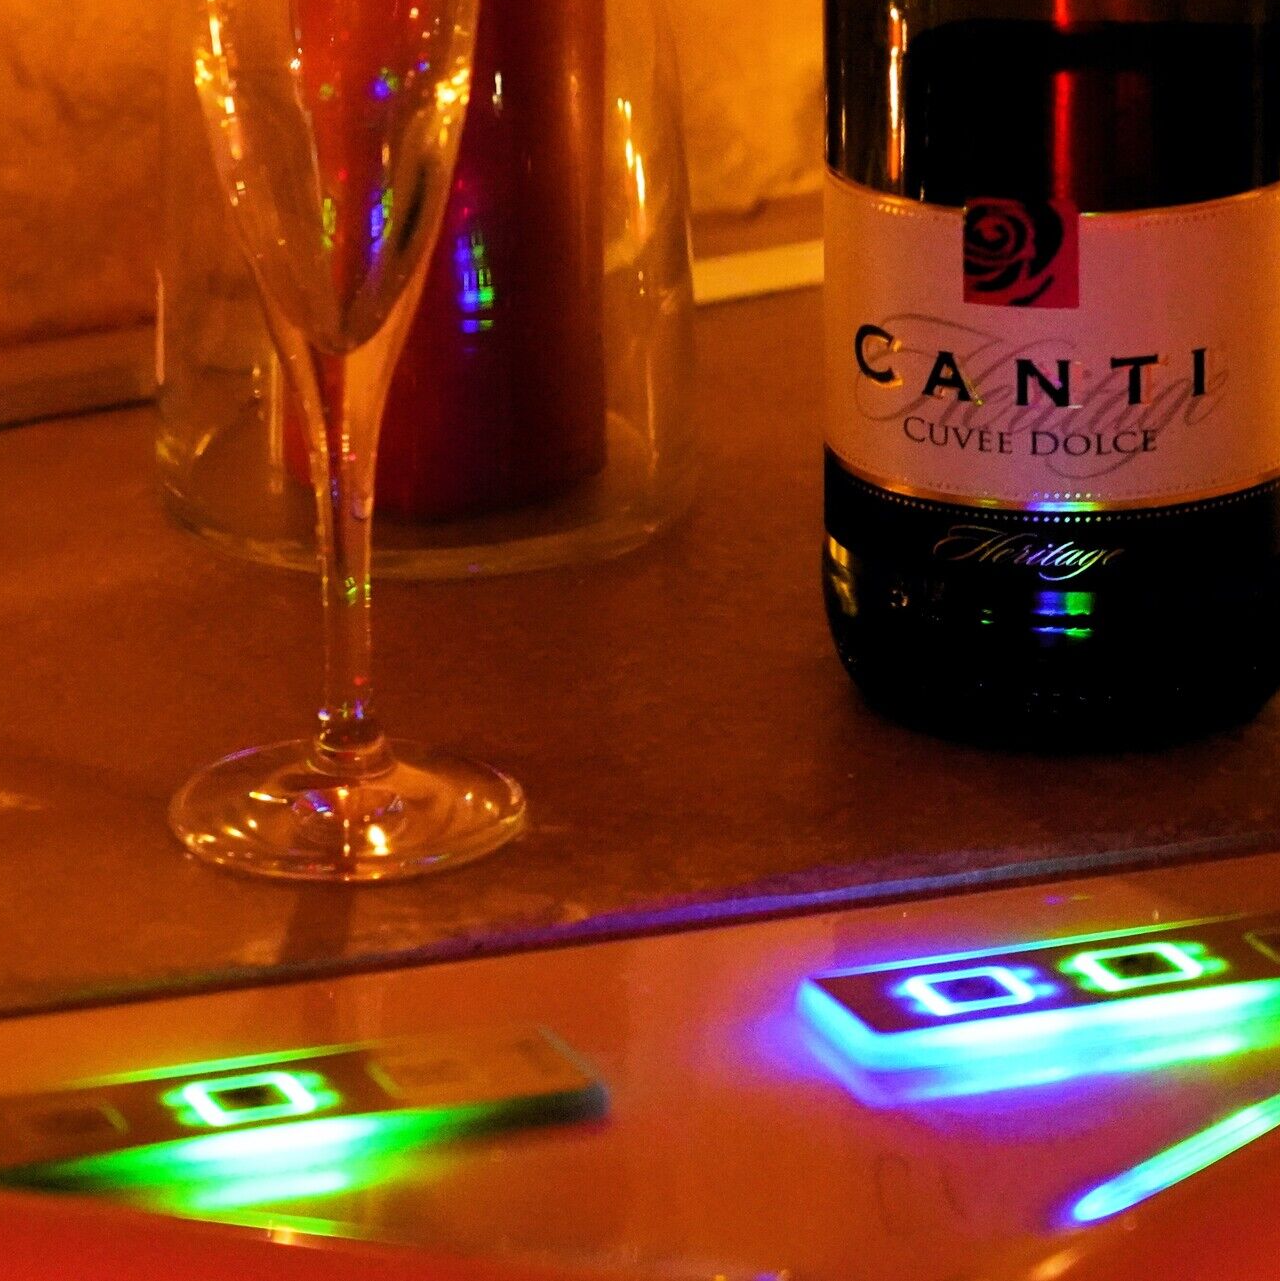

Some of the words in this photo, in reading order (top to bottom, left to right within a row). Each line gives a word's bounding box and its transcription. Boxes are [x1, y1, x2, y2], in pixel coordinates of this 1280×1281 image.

[854, 324, 1208, 408] CANTI
[1030, 429, 1158, 457] DOLCE
[932, 525, 1124, 581] Heritage
